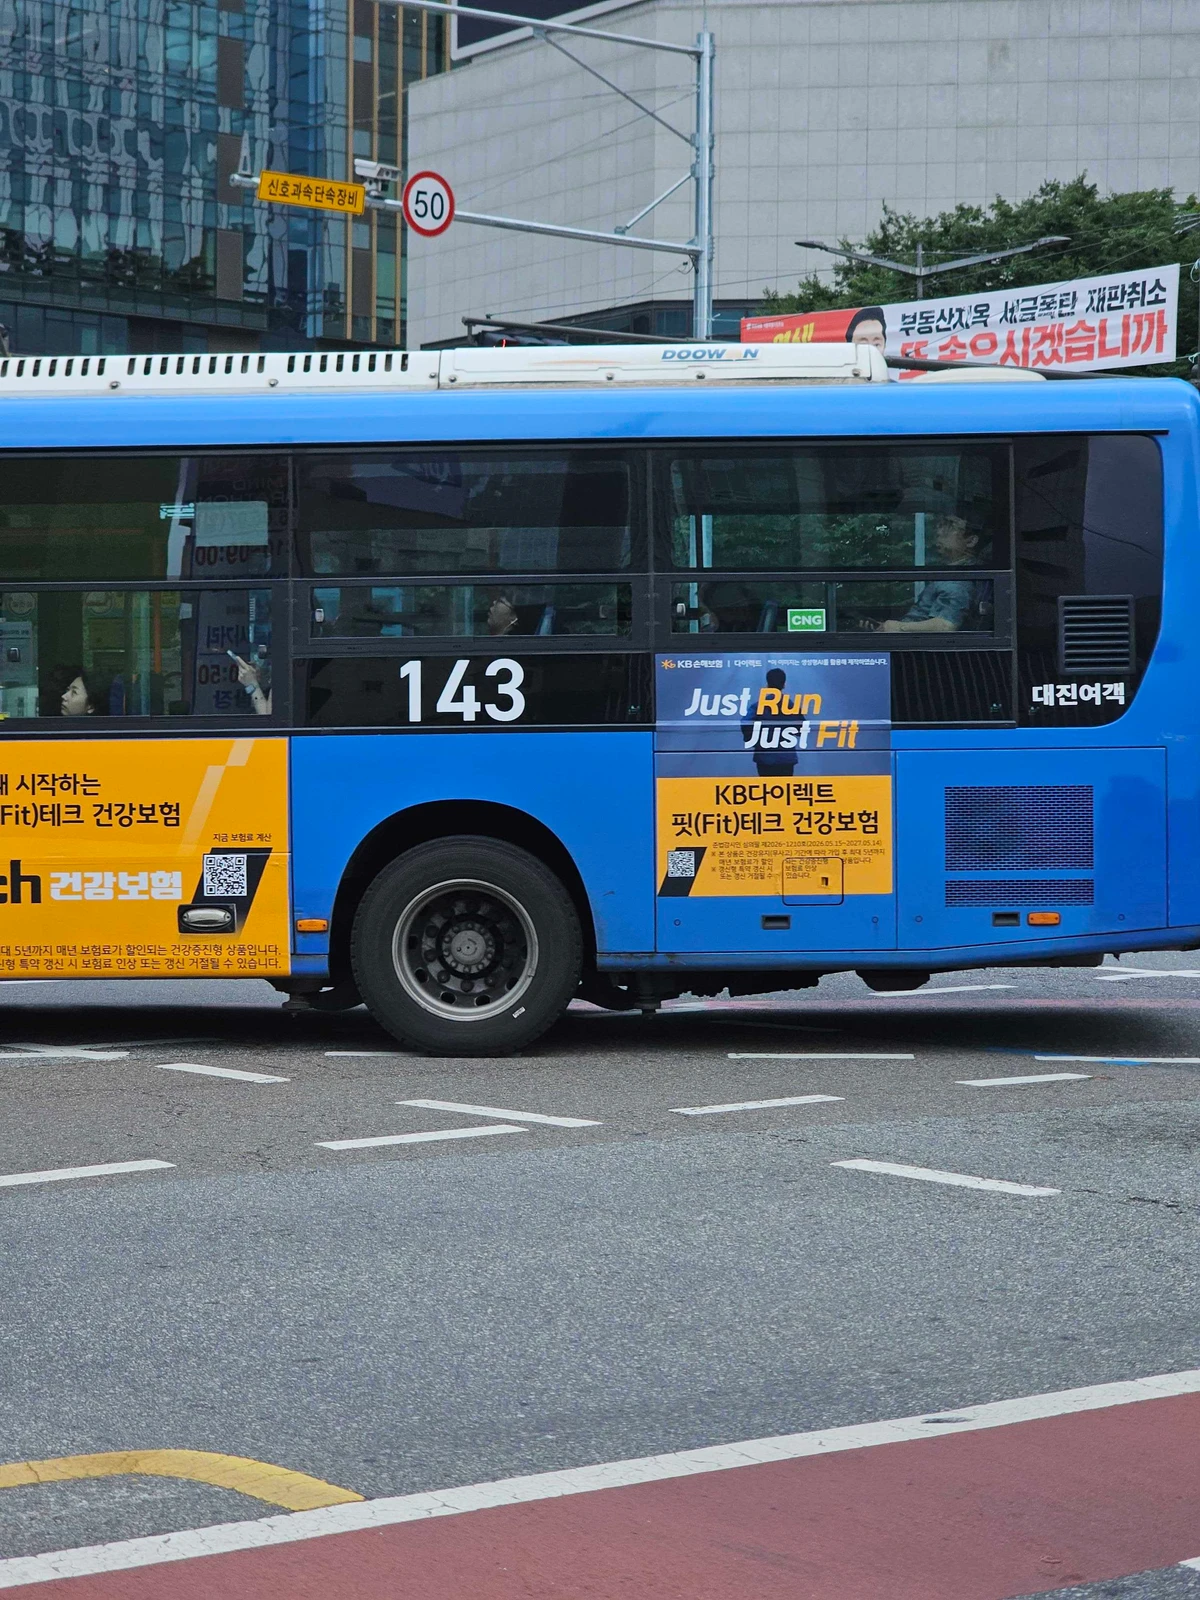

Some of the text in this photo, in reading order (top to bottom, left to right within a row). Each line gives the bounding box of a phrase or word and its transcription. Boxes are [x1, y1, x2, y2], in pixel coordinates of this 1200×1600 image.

[267, 178, 358, 208] 신호과속단속장비
[414, 190, 444, 220] 50
[899, 278, 1167, 336] 부동산지옥 세금폭탄 재판취소
[661, 349, 760, 360] DOOWN
[791, 615, 822, 626] CNG
[677, 659, 723, 669] KB손해보험
[734, 659, 763, 669] 다이렉트
[400, 658, 526, 722] 143
[684, 687, 822, 717] Just Run
[1032, 682, 1126, 706] 대진여객
[744, 720, 859, 749] Just Fit
[16, 773, 101, 796] 시작하는
[715, 783, 837, 806] KB다이렉트
[92, 802, 182, 827] 건강보험
[671, 809, 879, 838] 핏(Fit)테크 건강보험
[213, 833, 272, 842] 지금 보험료 계산
[0, 860, 183, 904] h 건강보험
[15, 945, 53, 957] 5년까지
[56, 945, 77, 956] 매년
[80, 945, 122, 956] 보험료가
[126, 944, 167, 956] 할인되는
[171, 944, 223, 957] 건강증진형
[226, 944, 281, 956] 상품입니다.
[19, 958, 40, 970] 특약
[44, 958, 64, 971] 갱신
[68, 958, 78, 970] 시
[82, 958, 112, 970] 보험료
[116, 958, 137, 970] 인상
[141, 958, 161, 970] 또는
[165, 958, 185, 970] 갱신
[189, 958, 220, 970] 거절될
[223, 958, 234, 969] 수
[236, 957, 282, 970] 있습니다.
